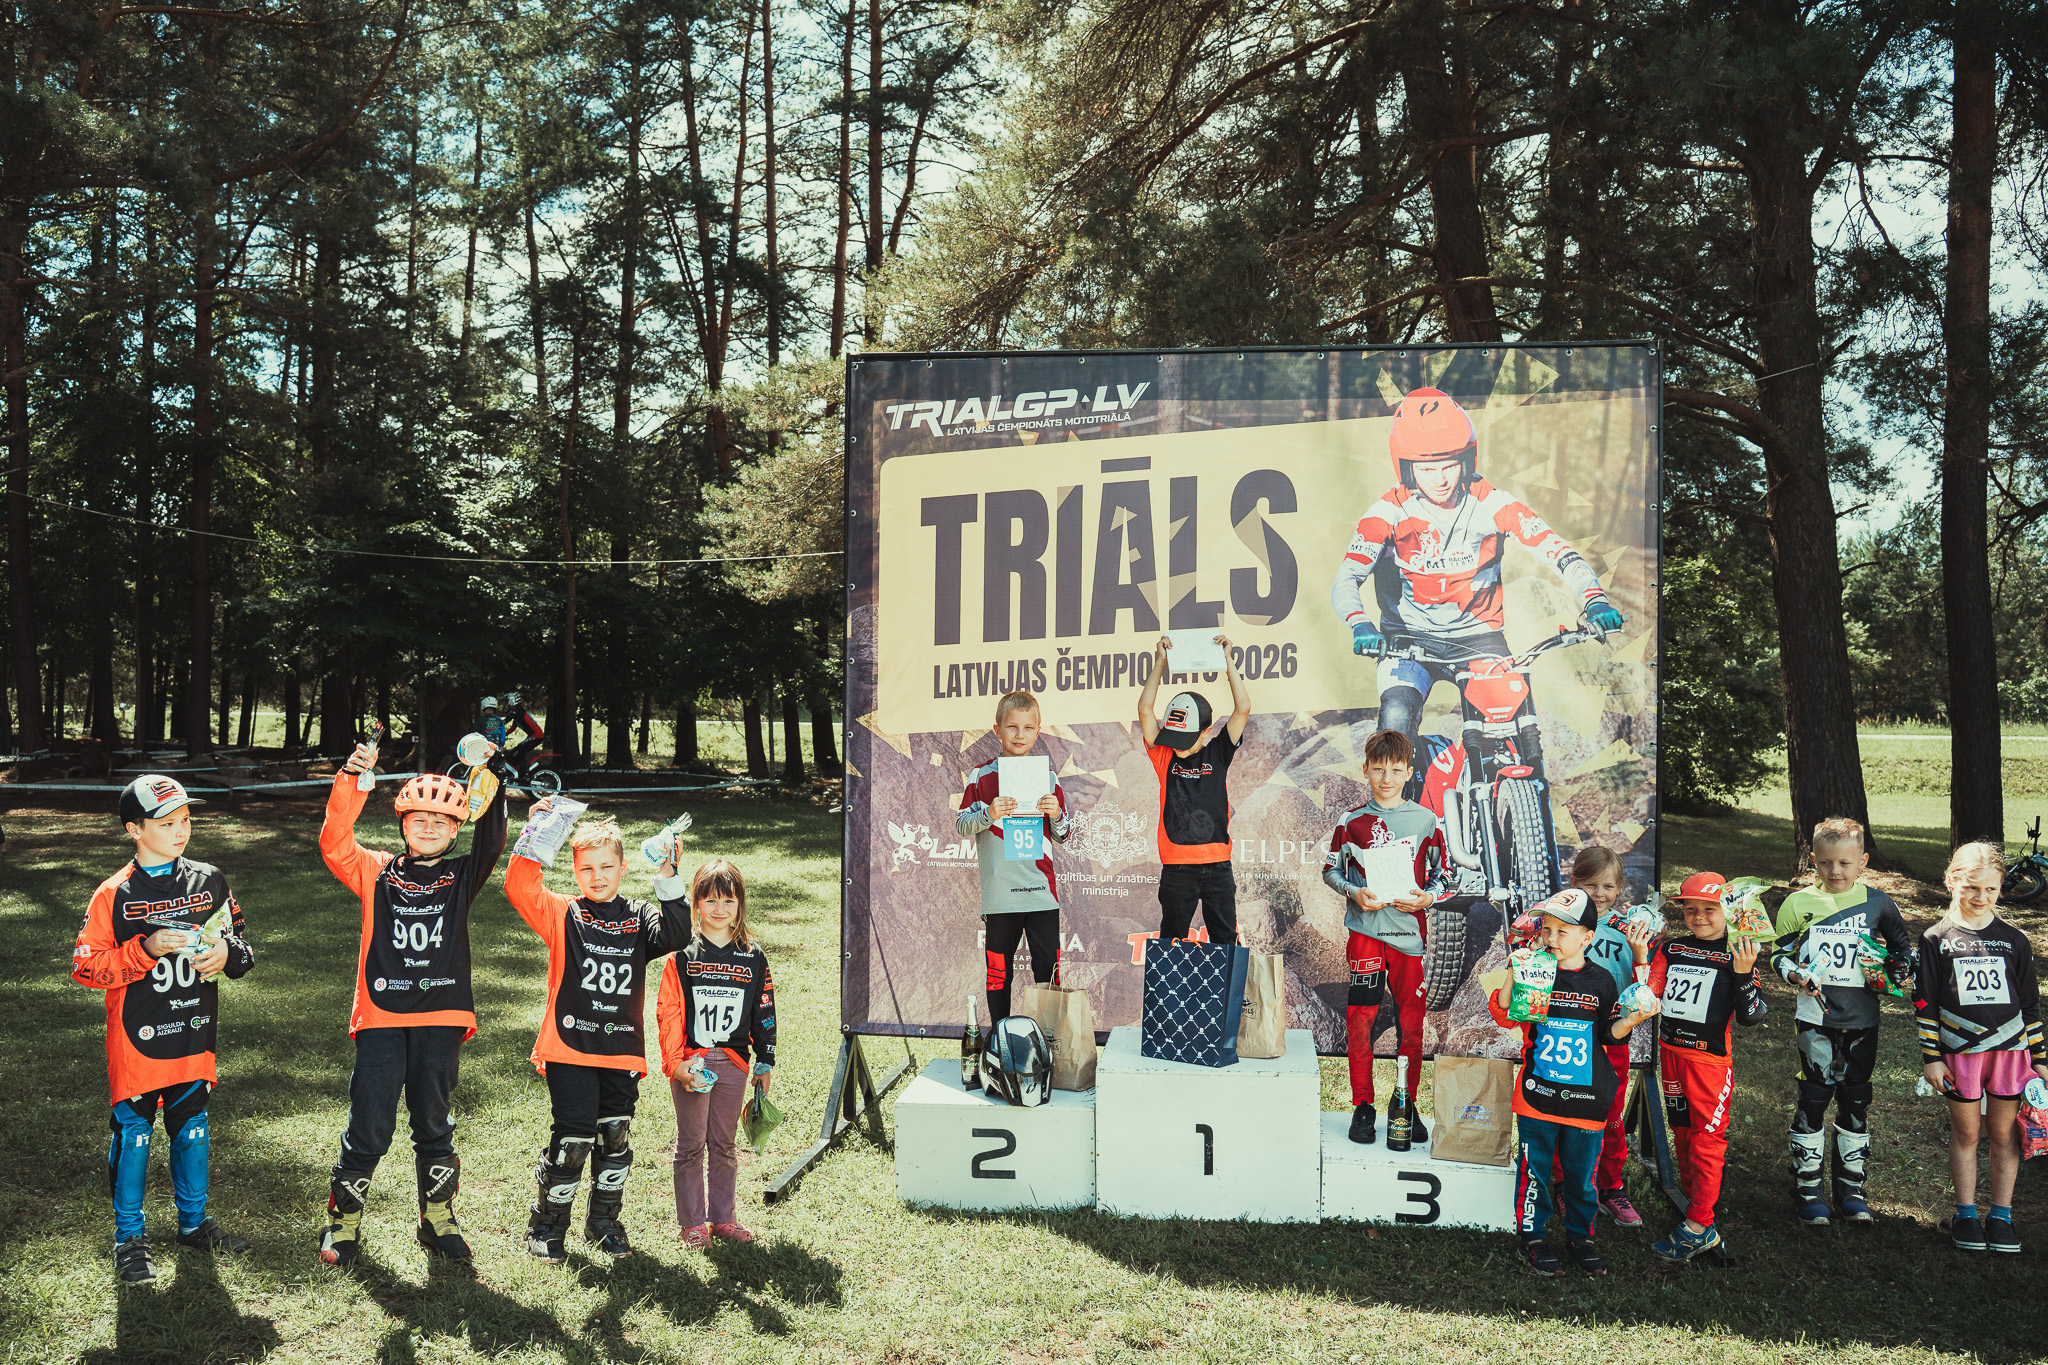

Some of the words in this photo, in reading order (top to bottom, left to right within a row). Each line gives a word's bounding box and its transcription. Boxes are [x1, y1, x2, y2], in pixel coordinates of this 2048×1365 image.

[947, 423, 996, 436] LATVIJAS
[997, 417, 1063, 432] ČEMPIONĀTS
[1064, 411, 1131, 426] MOTOTRIĀLĀ
[920, 455, 1298, 646] TRIĀLS
[1437, 577, 1447, 593] 1
[933, 657, 1047, 699] LATVIJAS
[928, 838, 979, 859] LaM
[1013, 829, 1034, 849] 95
[1055, 872, 1097, 884] zglītības
[1100, 874, 1113, 882] un
[1116, 873, 1159, 884] zinātnes
[1082, 886, 1129, 898] ministrija
[123, 890, 213, 920] SIGULDA
[190, 904, 213, 913] TEAM
[392, 915, 444, 952] 904
[151, 953, 199, 993] 90
[580, 957, 633, 996] 282
[687, 961, 753, 978] SIGULDA
[701, 973, 731, 981] RACING
[731, 975, 752, 984] TEAM
[1964, 969, 2002, 991] 203
[1550, 990, 1600, 1007] IGULDA
[1666, 977, 1703, 1005] 321
[699, 1003, 735, 1033] 115
[1242, 1006, 1255, 1015] PILS
[156, 1021, 186, 1031] SIGULDA
[1539, 1034, 1588, 1067] 253
[971, 1127, 1016, 1180] 2
[1195, 1122, 1214, 1176] 1
[1395, 1170, 1442, 1224] 3
